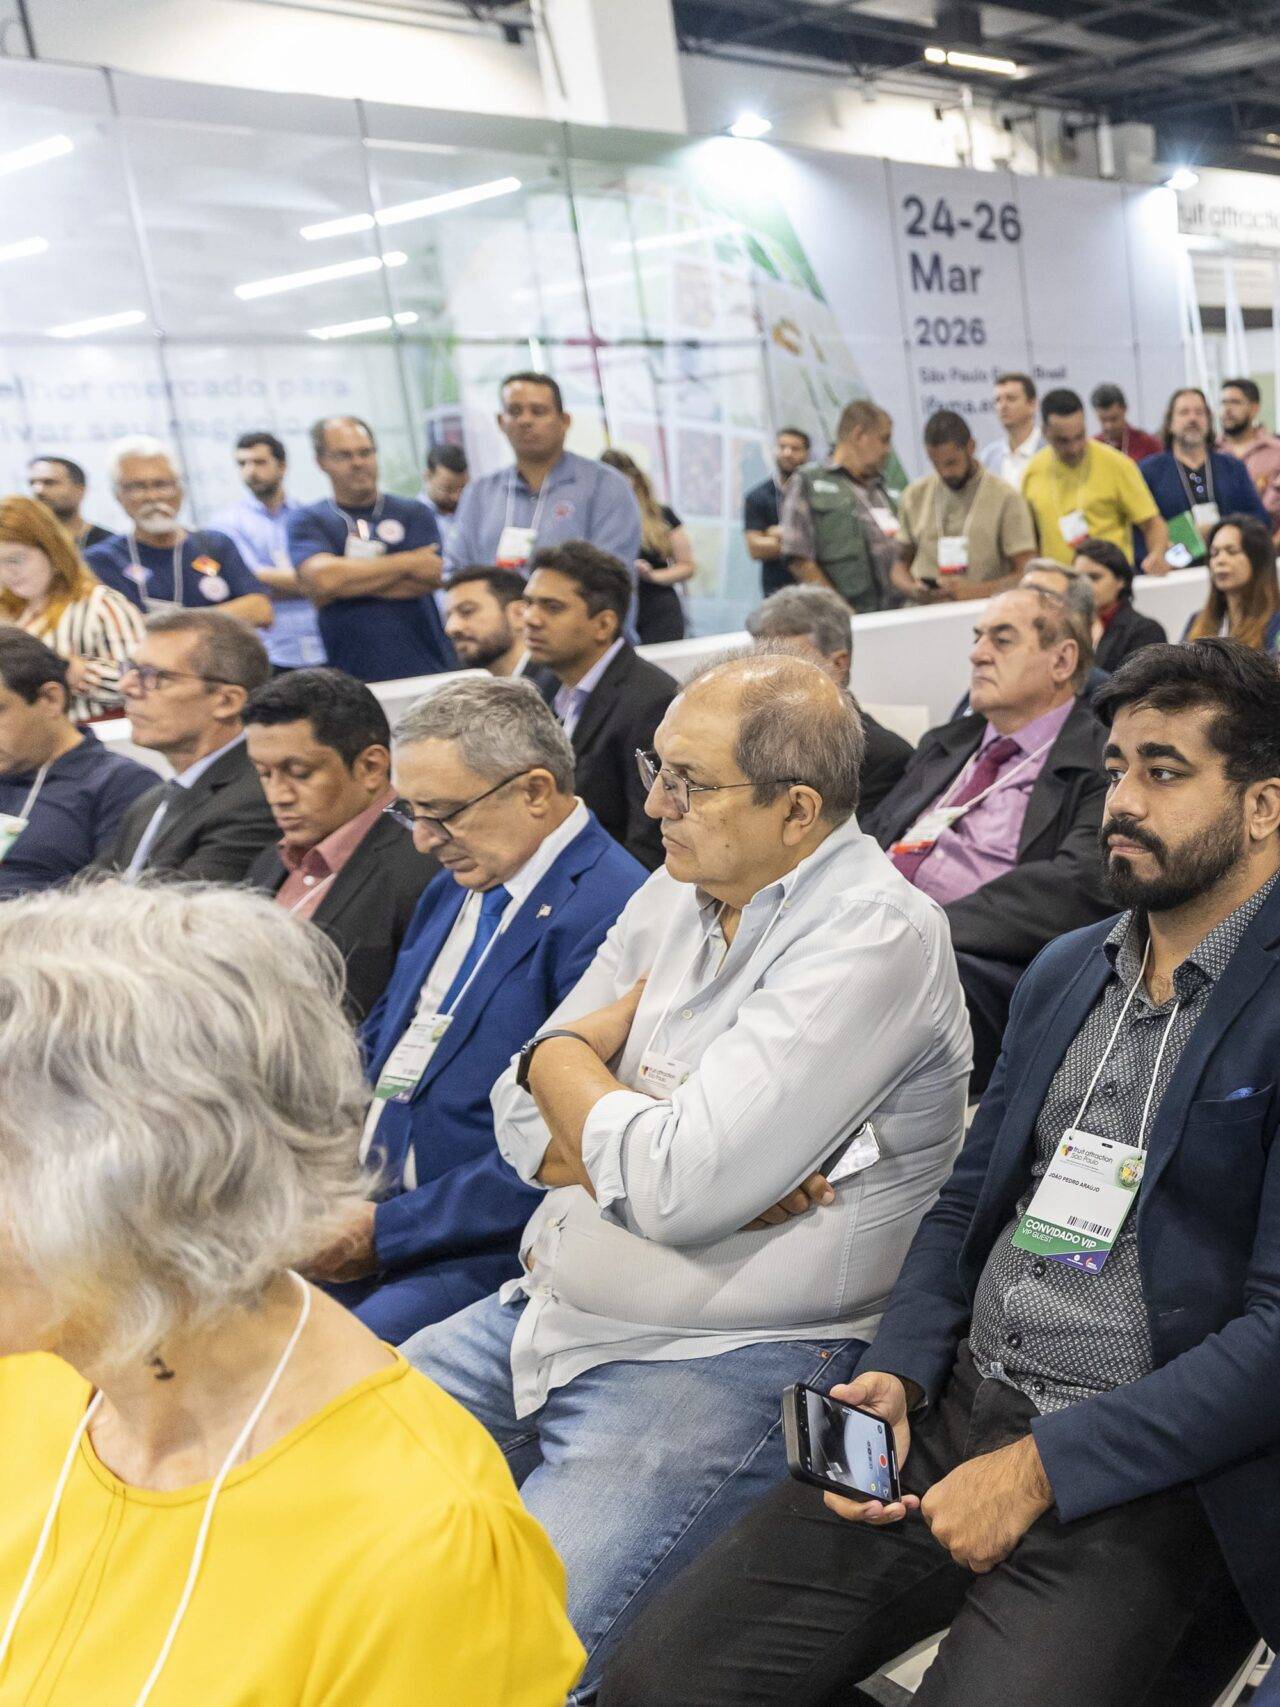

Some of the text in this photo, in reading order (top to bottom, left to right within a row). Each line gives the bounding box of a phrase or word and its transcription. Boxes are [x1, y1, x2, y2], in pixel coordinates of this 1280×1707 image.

[903, 195, 1021, 243] 24-26
[909, 252, 981, 293] Mar
[914, 317, 986, 346] 2026
[1025, 1218, 1098, 1249] CONVIDADO VIP
